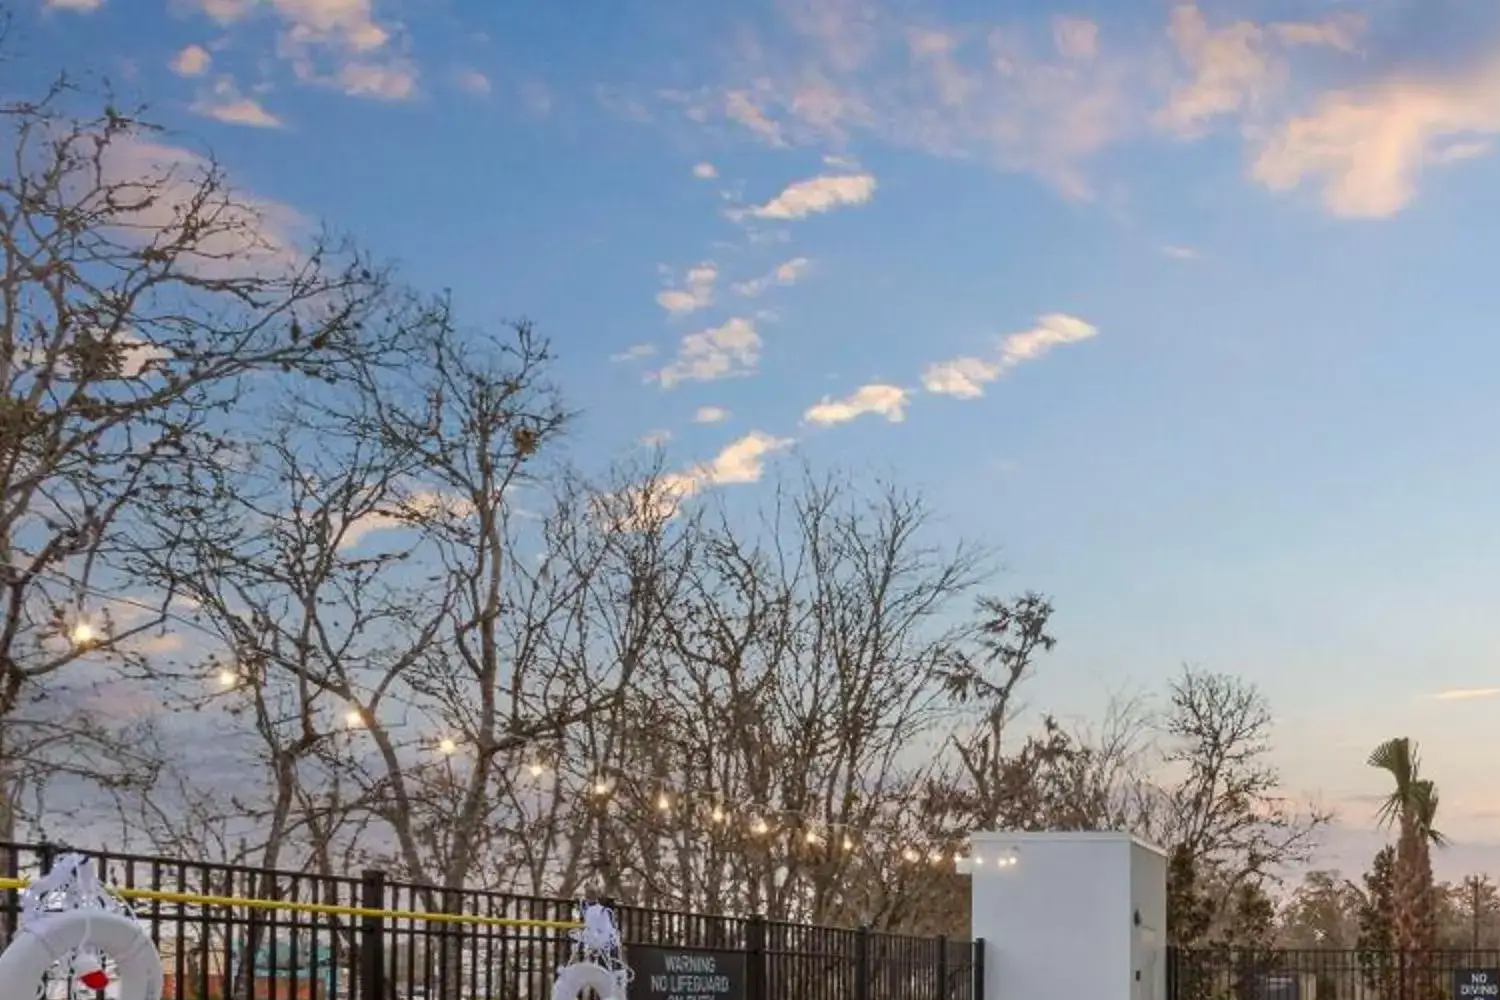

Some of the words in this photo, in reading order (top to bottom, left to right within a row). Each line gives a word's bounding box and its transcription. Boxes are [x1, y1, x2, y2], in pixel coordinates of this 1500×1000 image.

[664, 953, 716, 973] WARNING
[651, 975, 667, 992] NO
[670, 975, 729, 993] LIFEGUARD
[1471, 973, 1487, 983] NO
